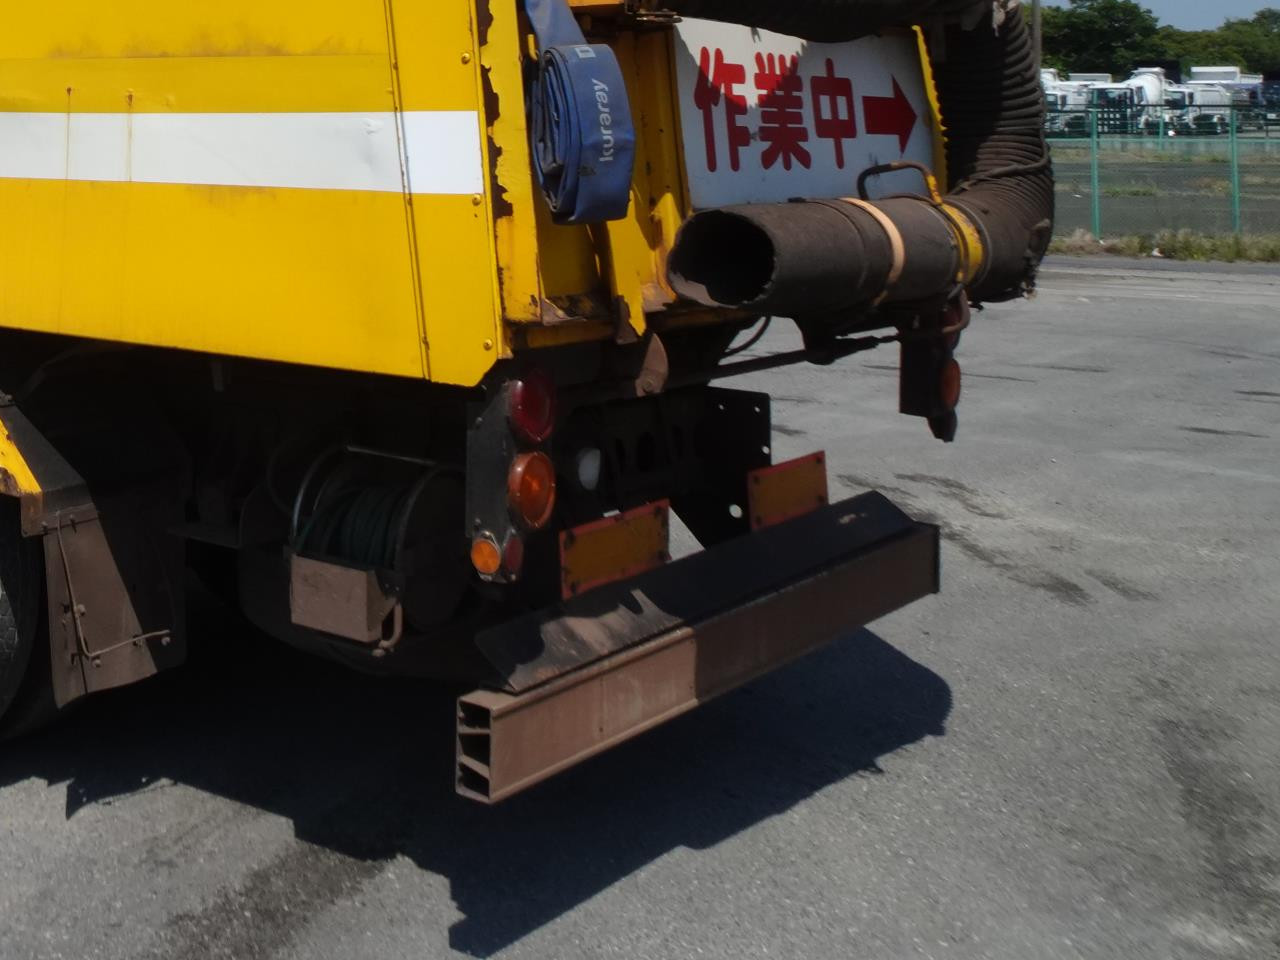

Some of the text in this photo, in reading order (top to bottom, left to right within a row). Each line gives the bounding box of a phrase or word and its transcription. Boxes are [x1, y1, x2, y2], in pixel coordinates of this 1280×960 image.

[598, 78, 615, 162] kuraray
[694, 46, 858, 172] 作業中
